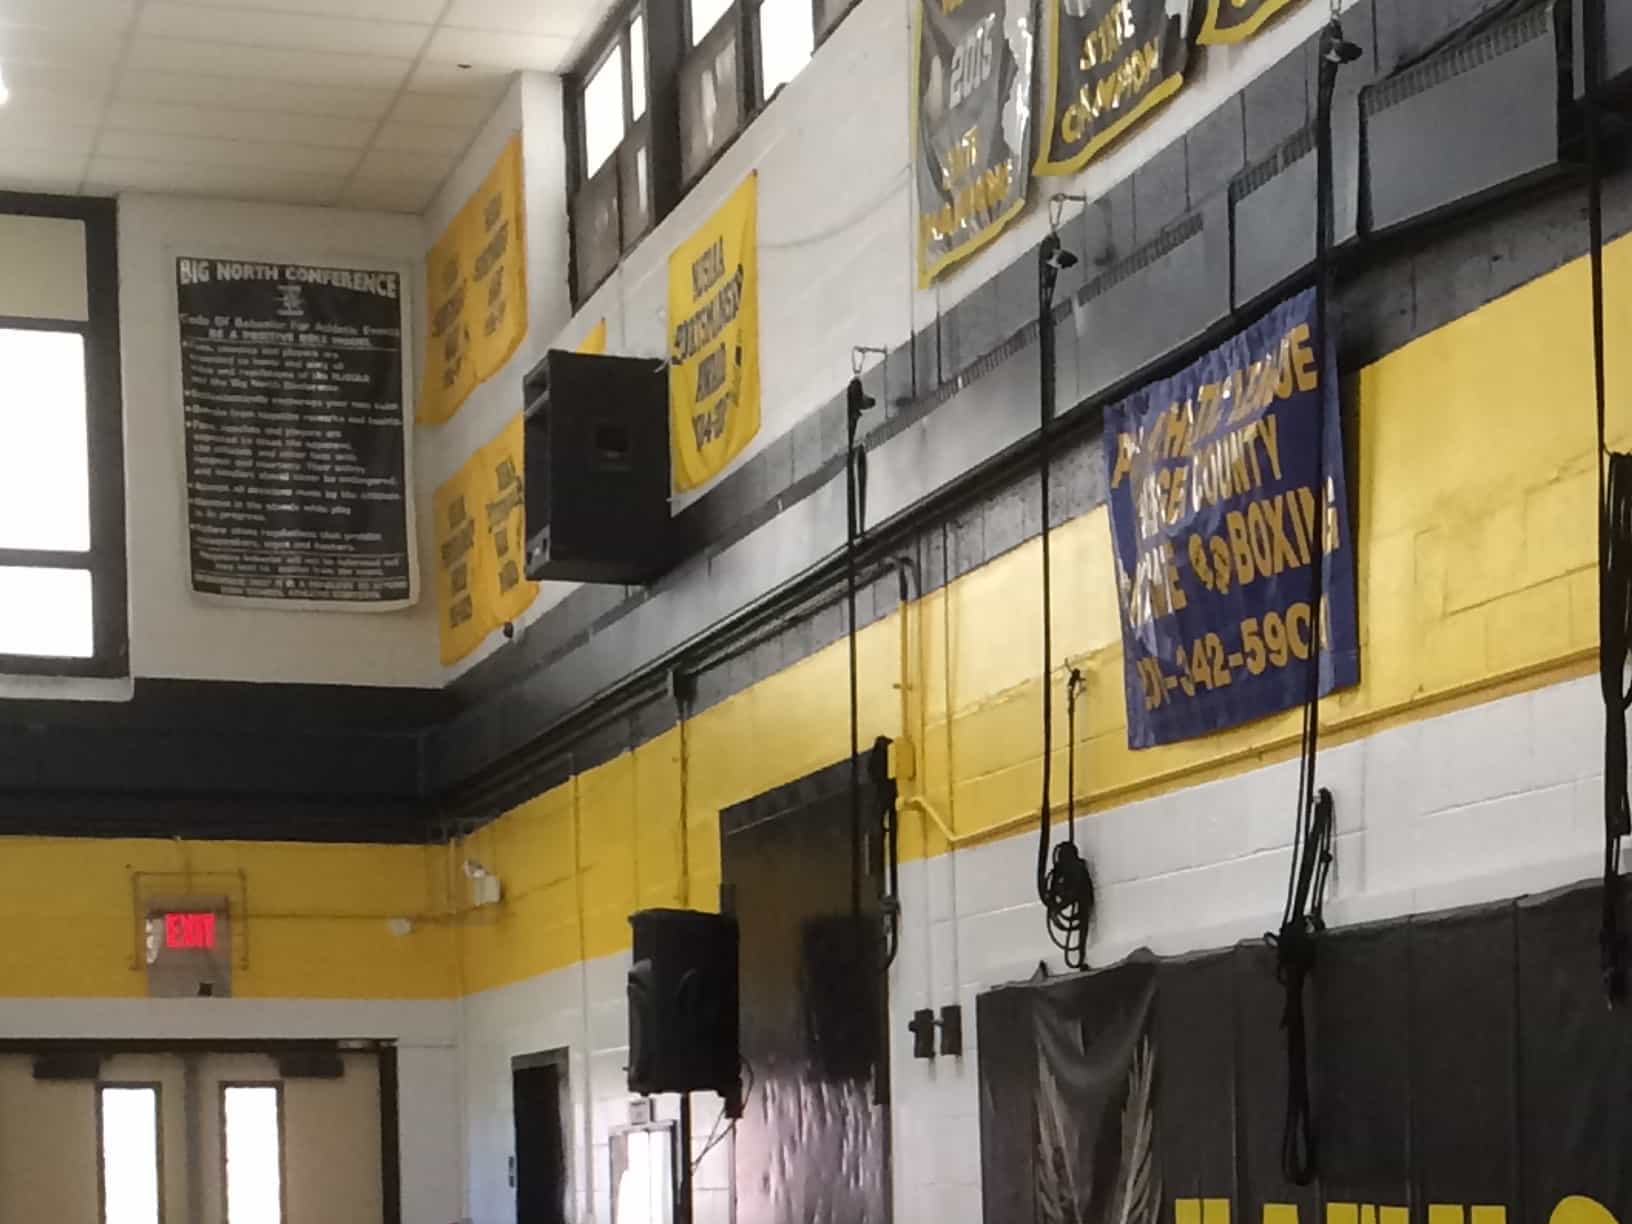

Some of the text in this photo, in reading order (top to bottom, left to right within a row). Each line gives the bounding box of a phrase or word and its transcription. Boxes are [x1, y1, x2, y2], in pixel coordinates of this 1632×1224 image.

[180, 259, 397, 298] BIG NORTH CONFERENCE
[1192, 414, 1282, 511] COUNTY
